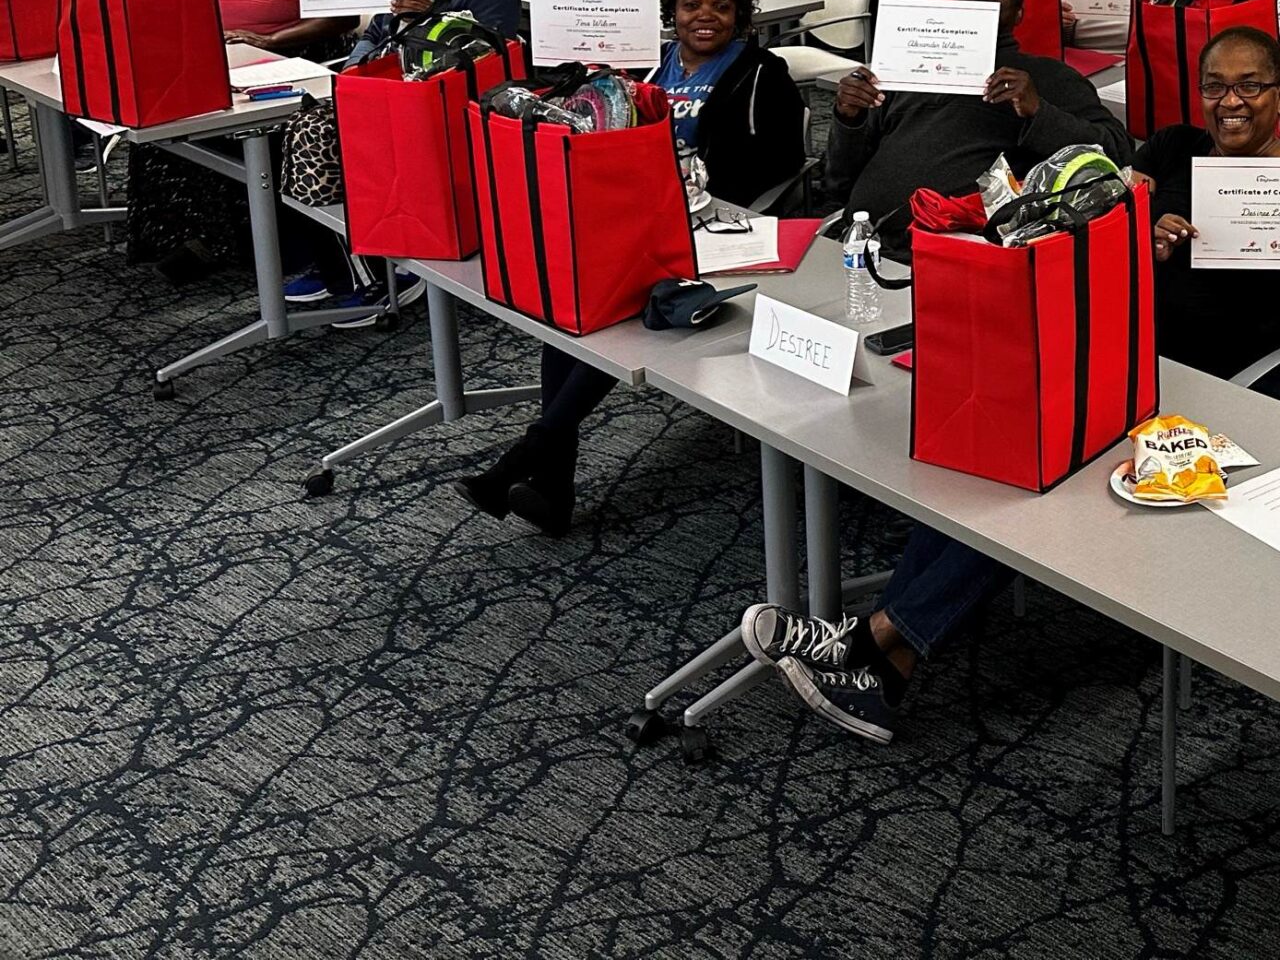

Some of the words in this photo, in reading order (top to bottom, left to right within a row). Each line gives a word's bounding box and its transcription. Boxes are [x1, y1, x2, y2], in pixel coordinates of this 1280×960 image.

[1241, 208, 1270, 217] Desiree
[766, 307, 832, 370] DESIREE
[1144, 437, 1208, 454] BAKED
